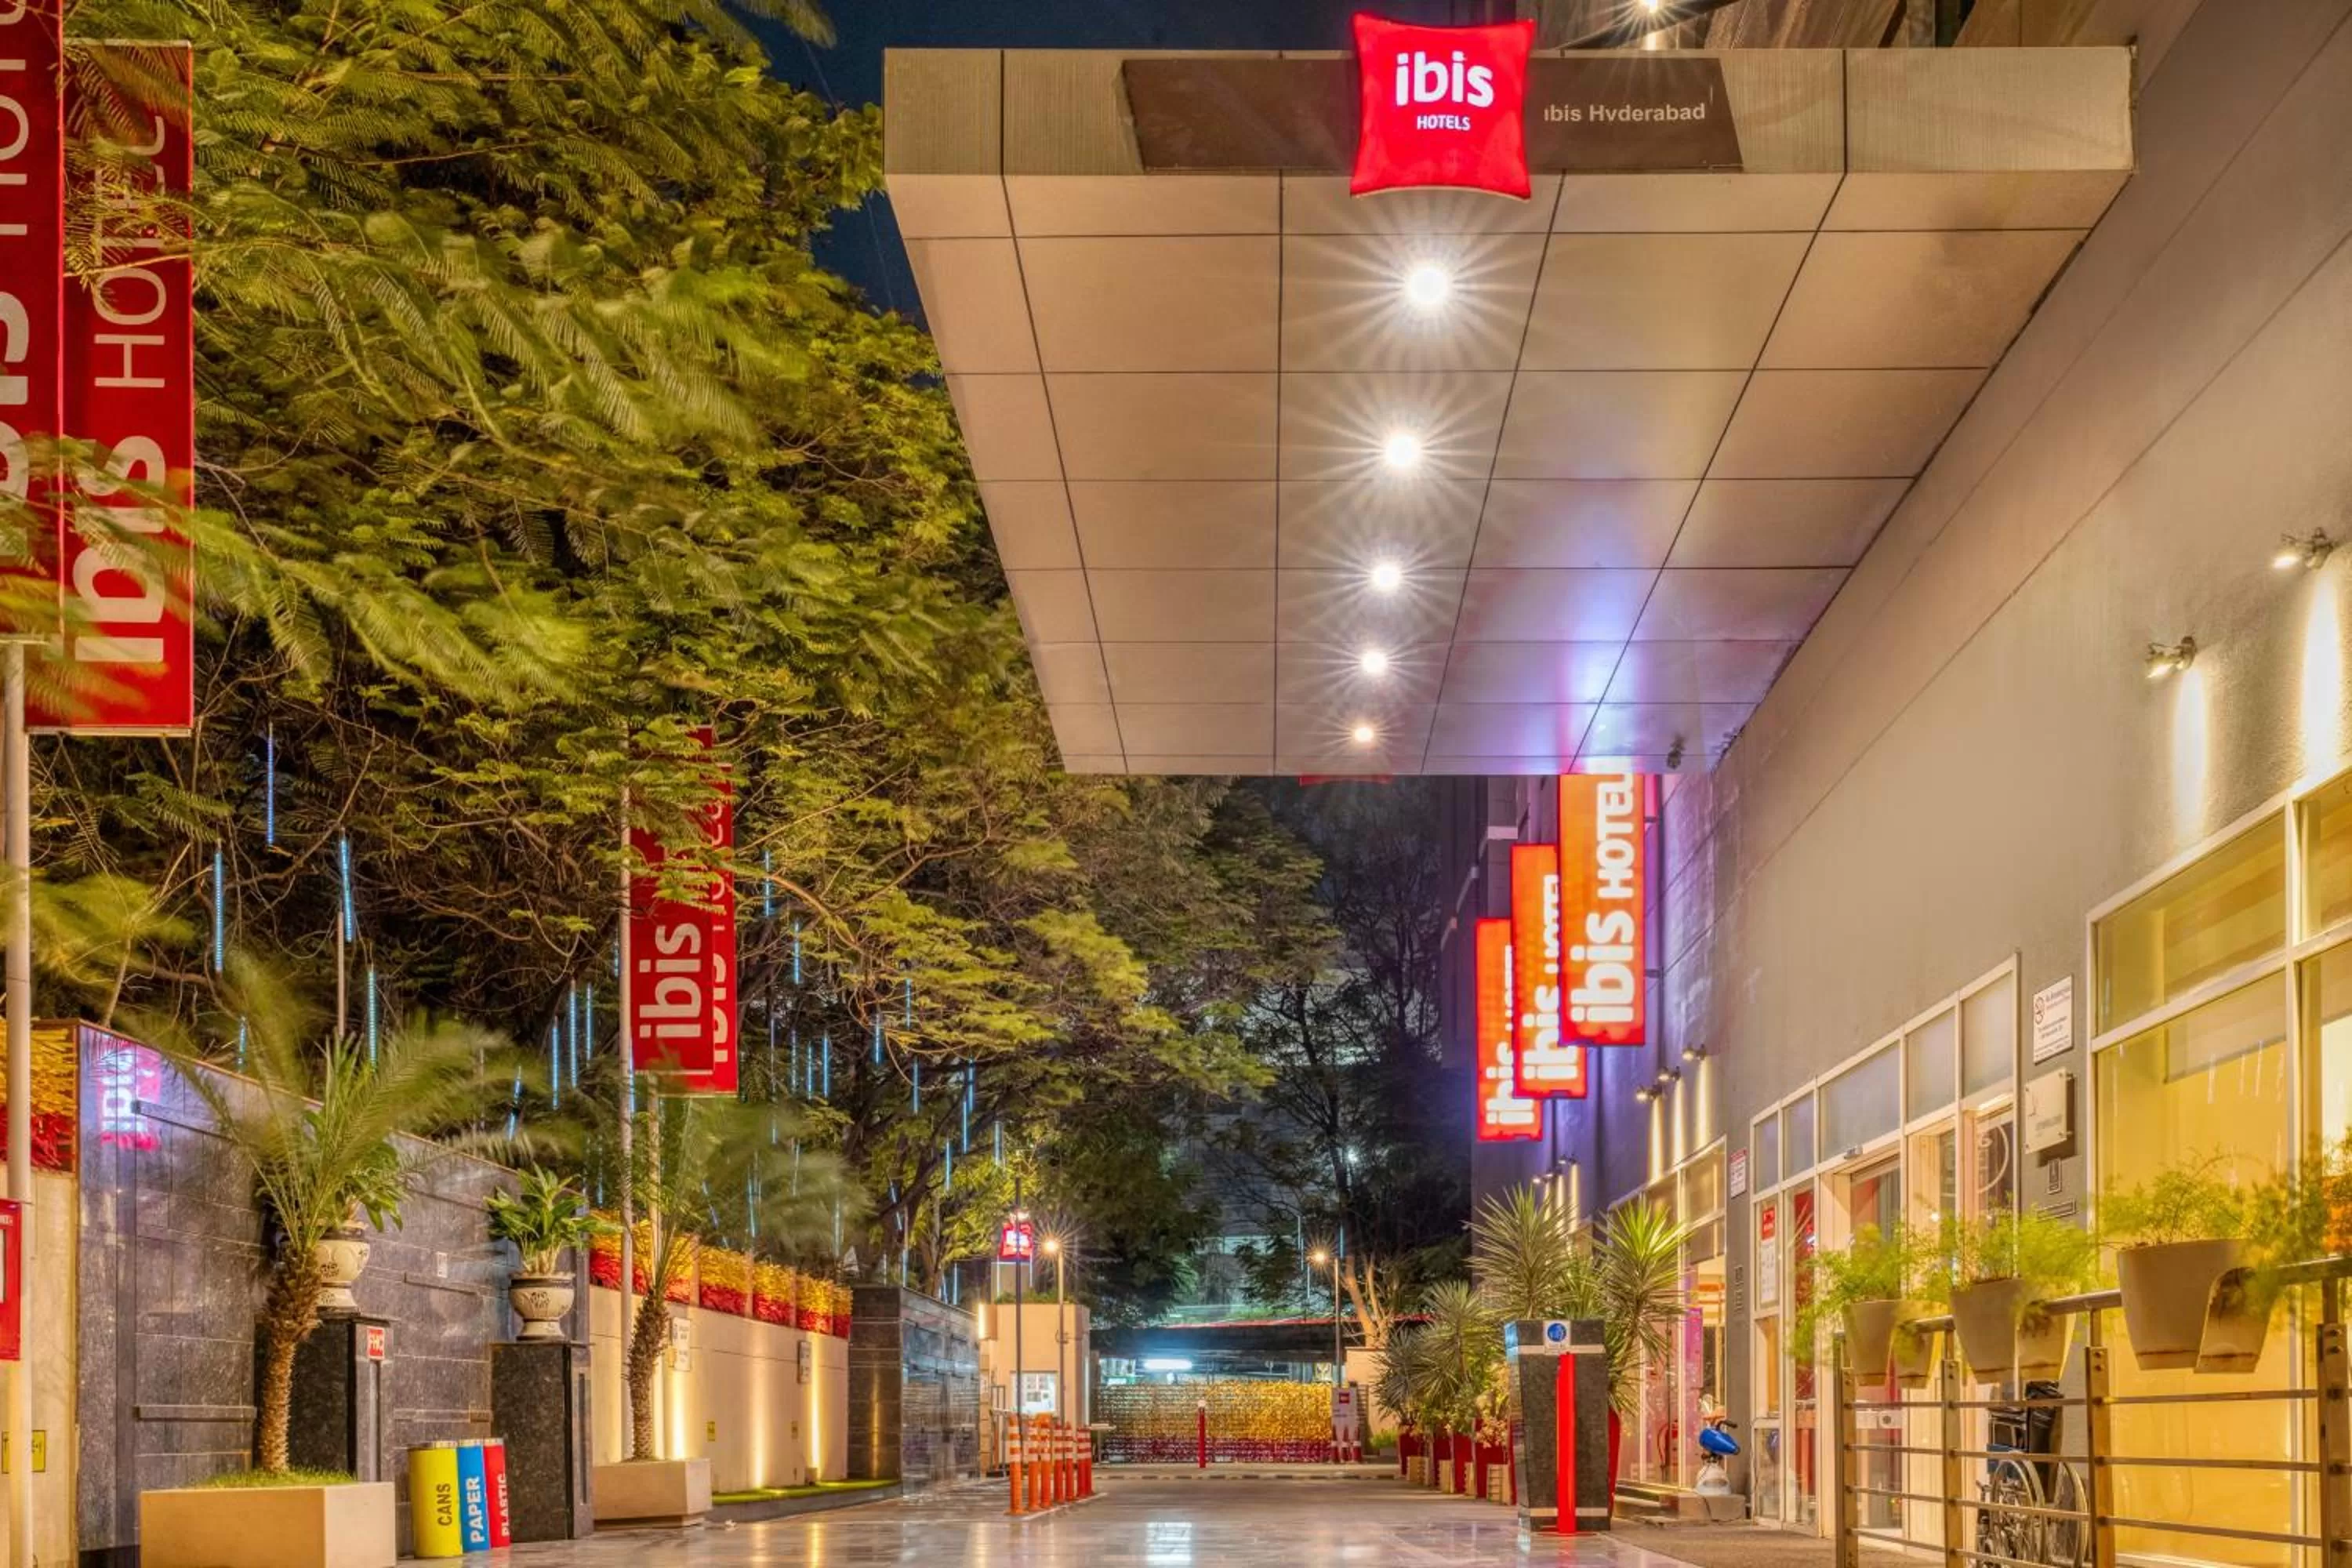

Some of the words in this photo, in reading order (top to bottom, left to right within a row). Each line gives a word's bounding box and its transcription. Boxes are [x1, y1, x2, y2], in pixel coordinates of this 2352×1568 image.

[1396, 50, 1494, 108] ibis
[1417, 114, 1472, 132] HOTELS
[1544, 103, 1582, 122] ibis
[639, 922, 702, 1038] ibis
[1570, 911, 1635, 1023] ibis
[436, 1483, 453, 1526] CANS
[465, 1475, 486, 1544] PAPER
[496, 1472, 510, 1537] PLASTIC
